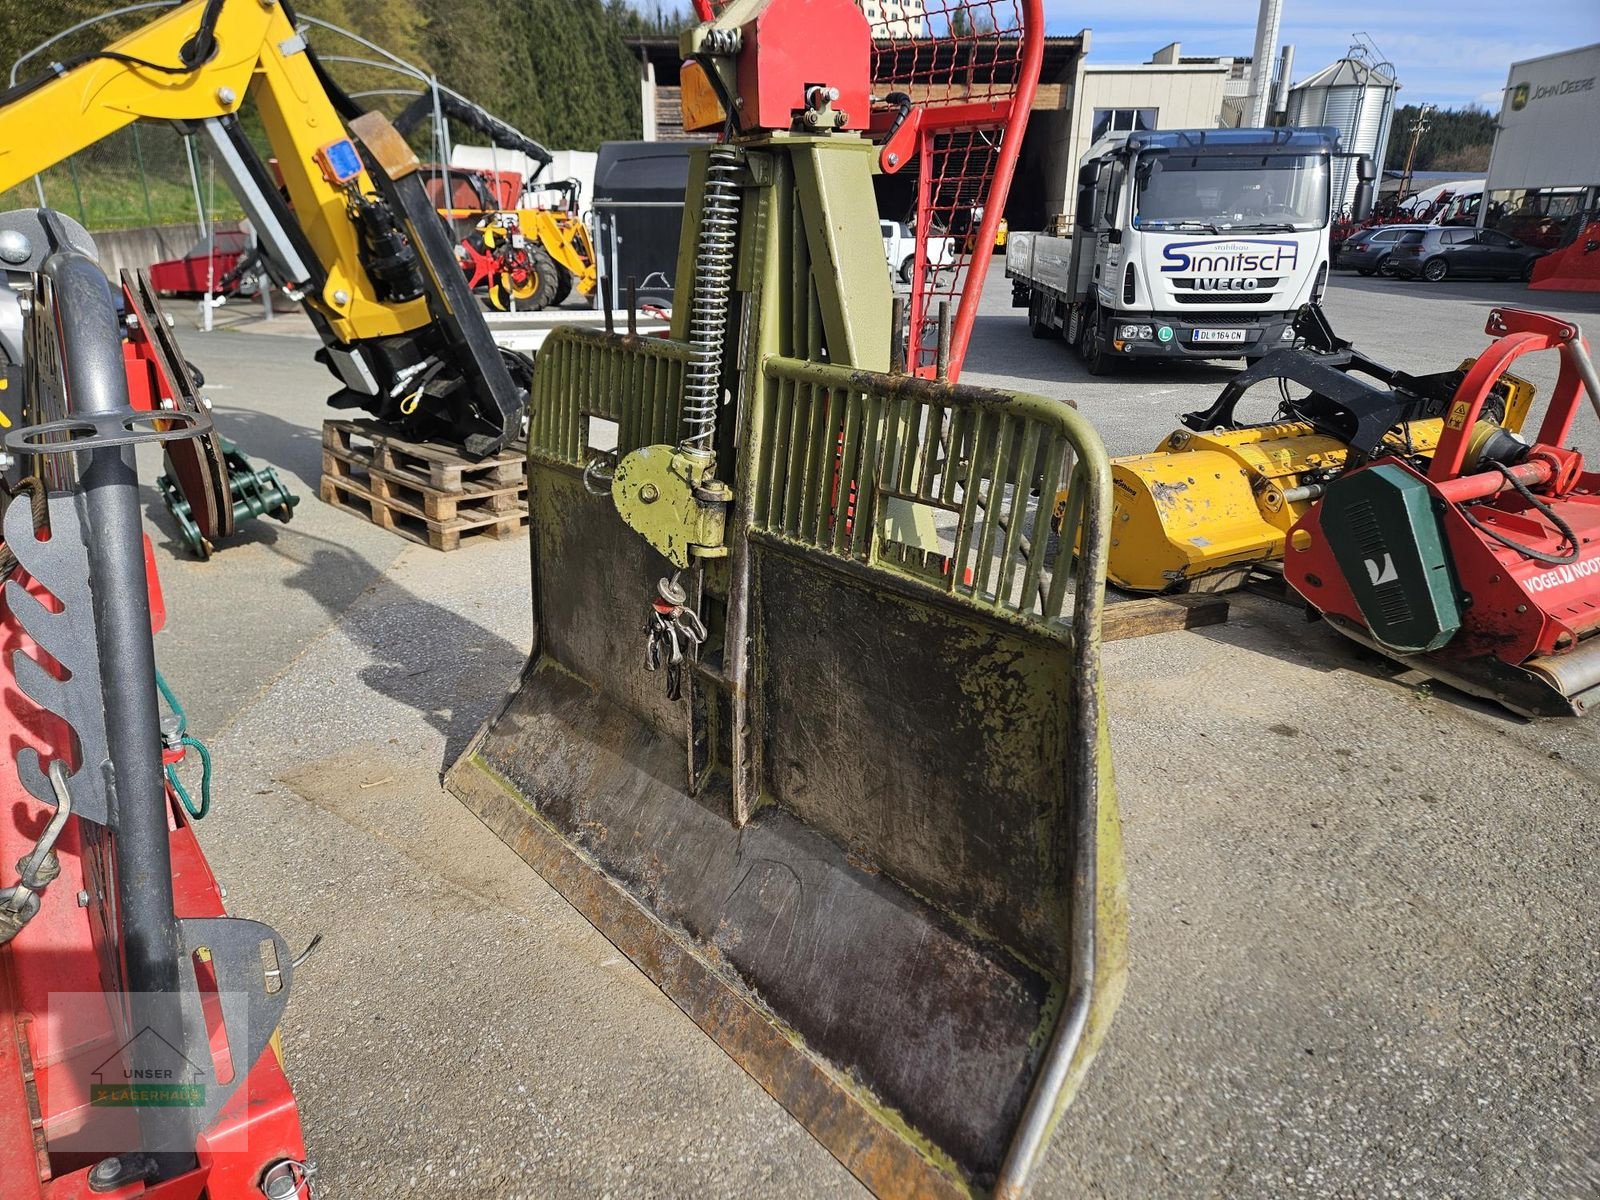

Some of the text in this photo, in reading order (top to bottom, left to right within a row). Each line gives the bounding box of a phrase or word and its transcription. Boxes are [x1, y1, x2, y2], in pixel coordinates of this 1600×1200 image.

[1531, 77, 1597, 100] JOHN DEERE
[1193, 277, 1259, 291] IVECO
[1200, 331, 1242, 340] DL 164 CN
[1523, 570, 1564, 594] VOGEL
